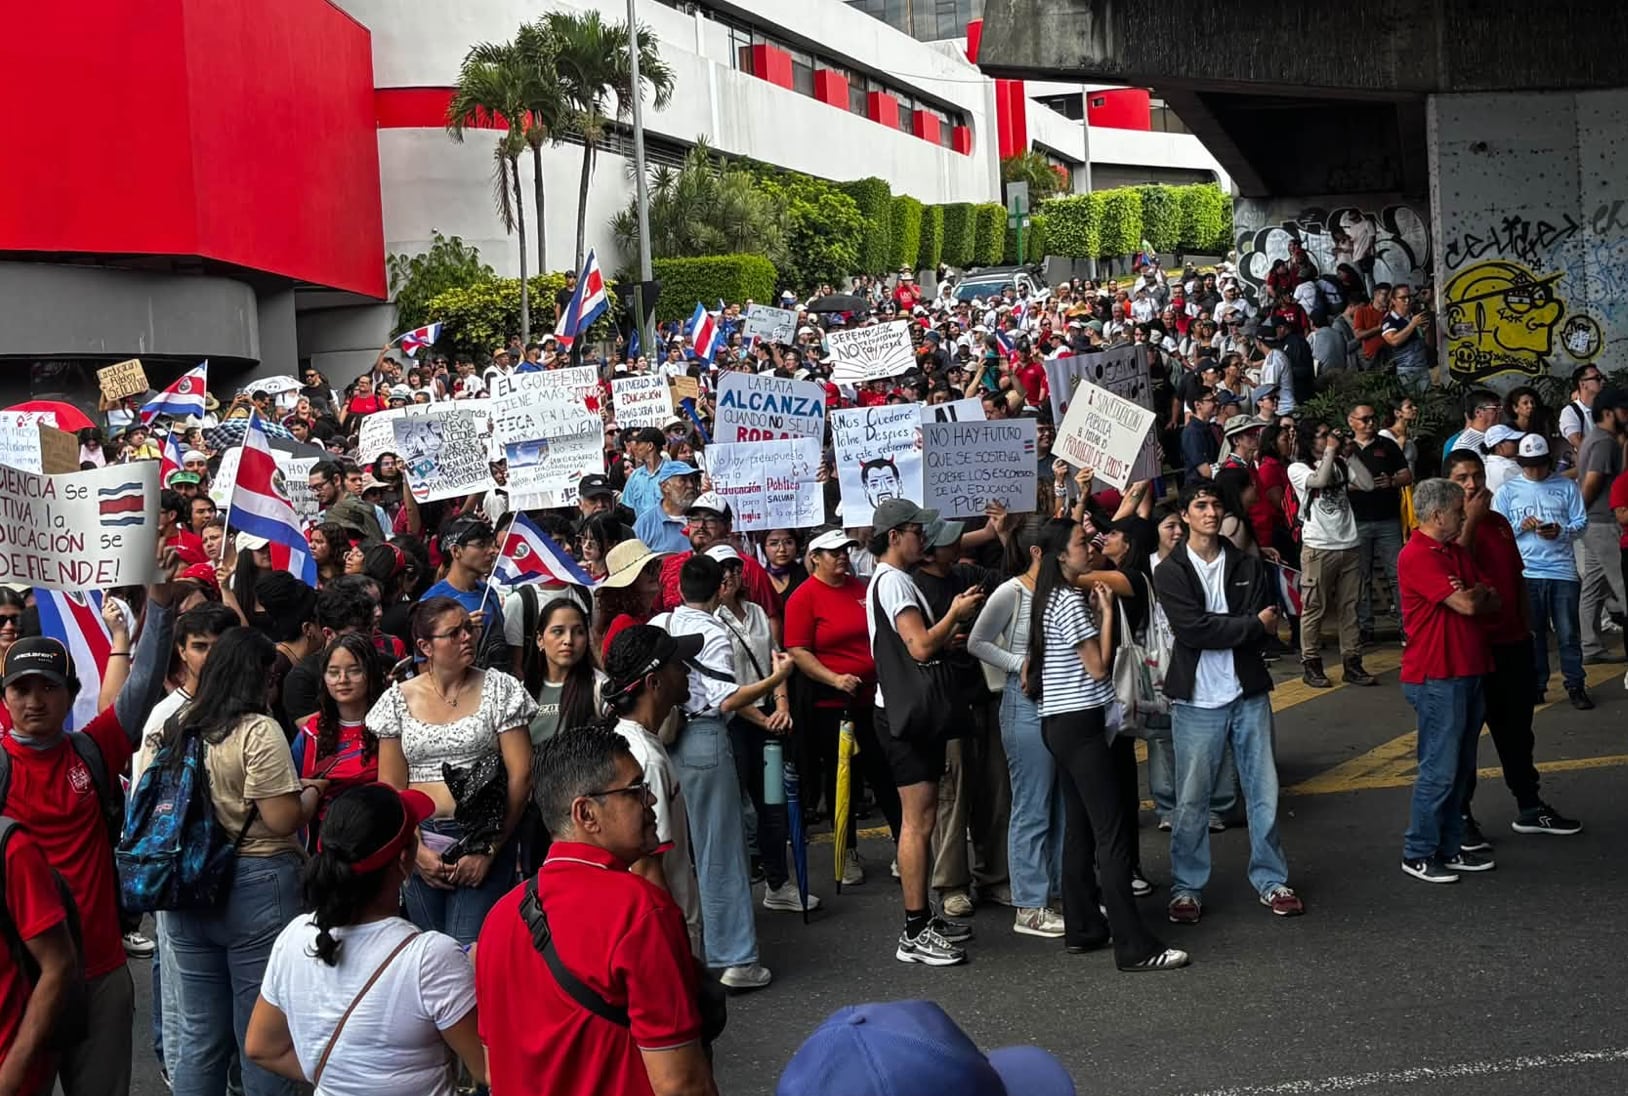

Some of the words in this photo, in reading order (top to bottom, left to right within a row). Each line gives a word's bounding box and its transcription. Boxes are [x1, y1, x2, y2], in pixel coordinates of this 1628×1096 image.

[498, 378, 517, 397] EL
[520, 368, 594, 390] GOBIERNO
[748, 375, 761, 390] LA
[764, 378, 794, 394] PLATA
[492, 392, 533, 413] TIENE
[719, 388, 823, 418] ALCANZA
[736, 425, 805, 443] ROB
[768, 414, 784, 430] NO
[787, 417, 803, 433] SE
[806, 419, 821, 436] LA
[929, 427, 950, 448] NO
[953, 426, 980, 447] HAY
[982, 426, 1022, 442] FUTURO
[927, 451, 953, 469] QUE
[954, 450, 972, 466] SE
[975, 450, 1021, 464] SOSTENGA
[287, 463, 311, 476] HOY
[929, 470, 966, 486] SOBRE
[968, 468, 991, 482] LOS
[64, 483, 89, 500] se
[714, 480, 762, 495] Educación
[935, 486, 949, 497] DE
[950, 484, 964, 494] LA
[967, 480, 1023, 495] EDUCACIÓN
[0, 495, 38, 528] TIVA,
[46, 503, 65, 528] la
[100, 534, 123, 550] se
